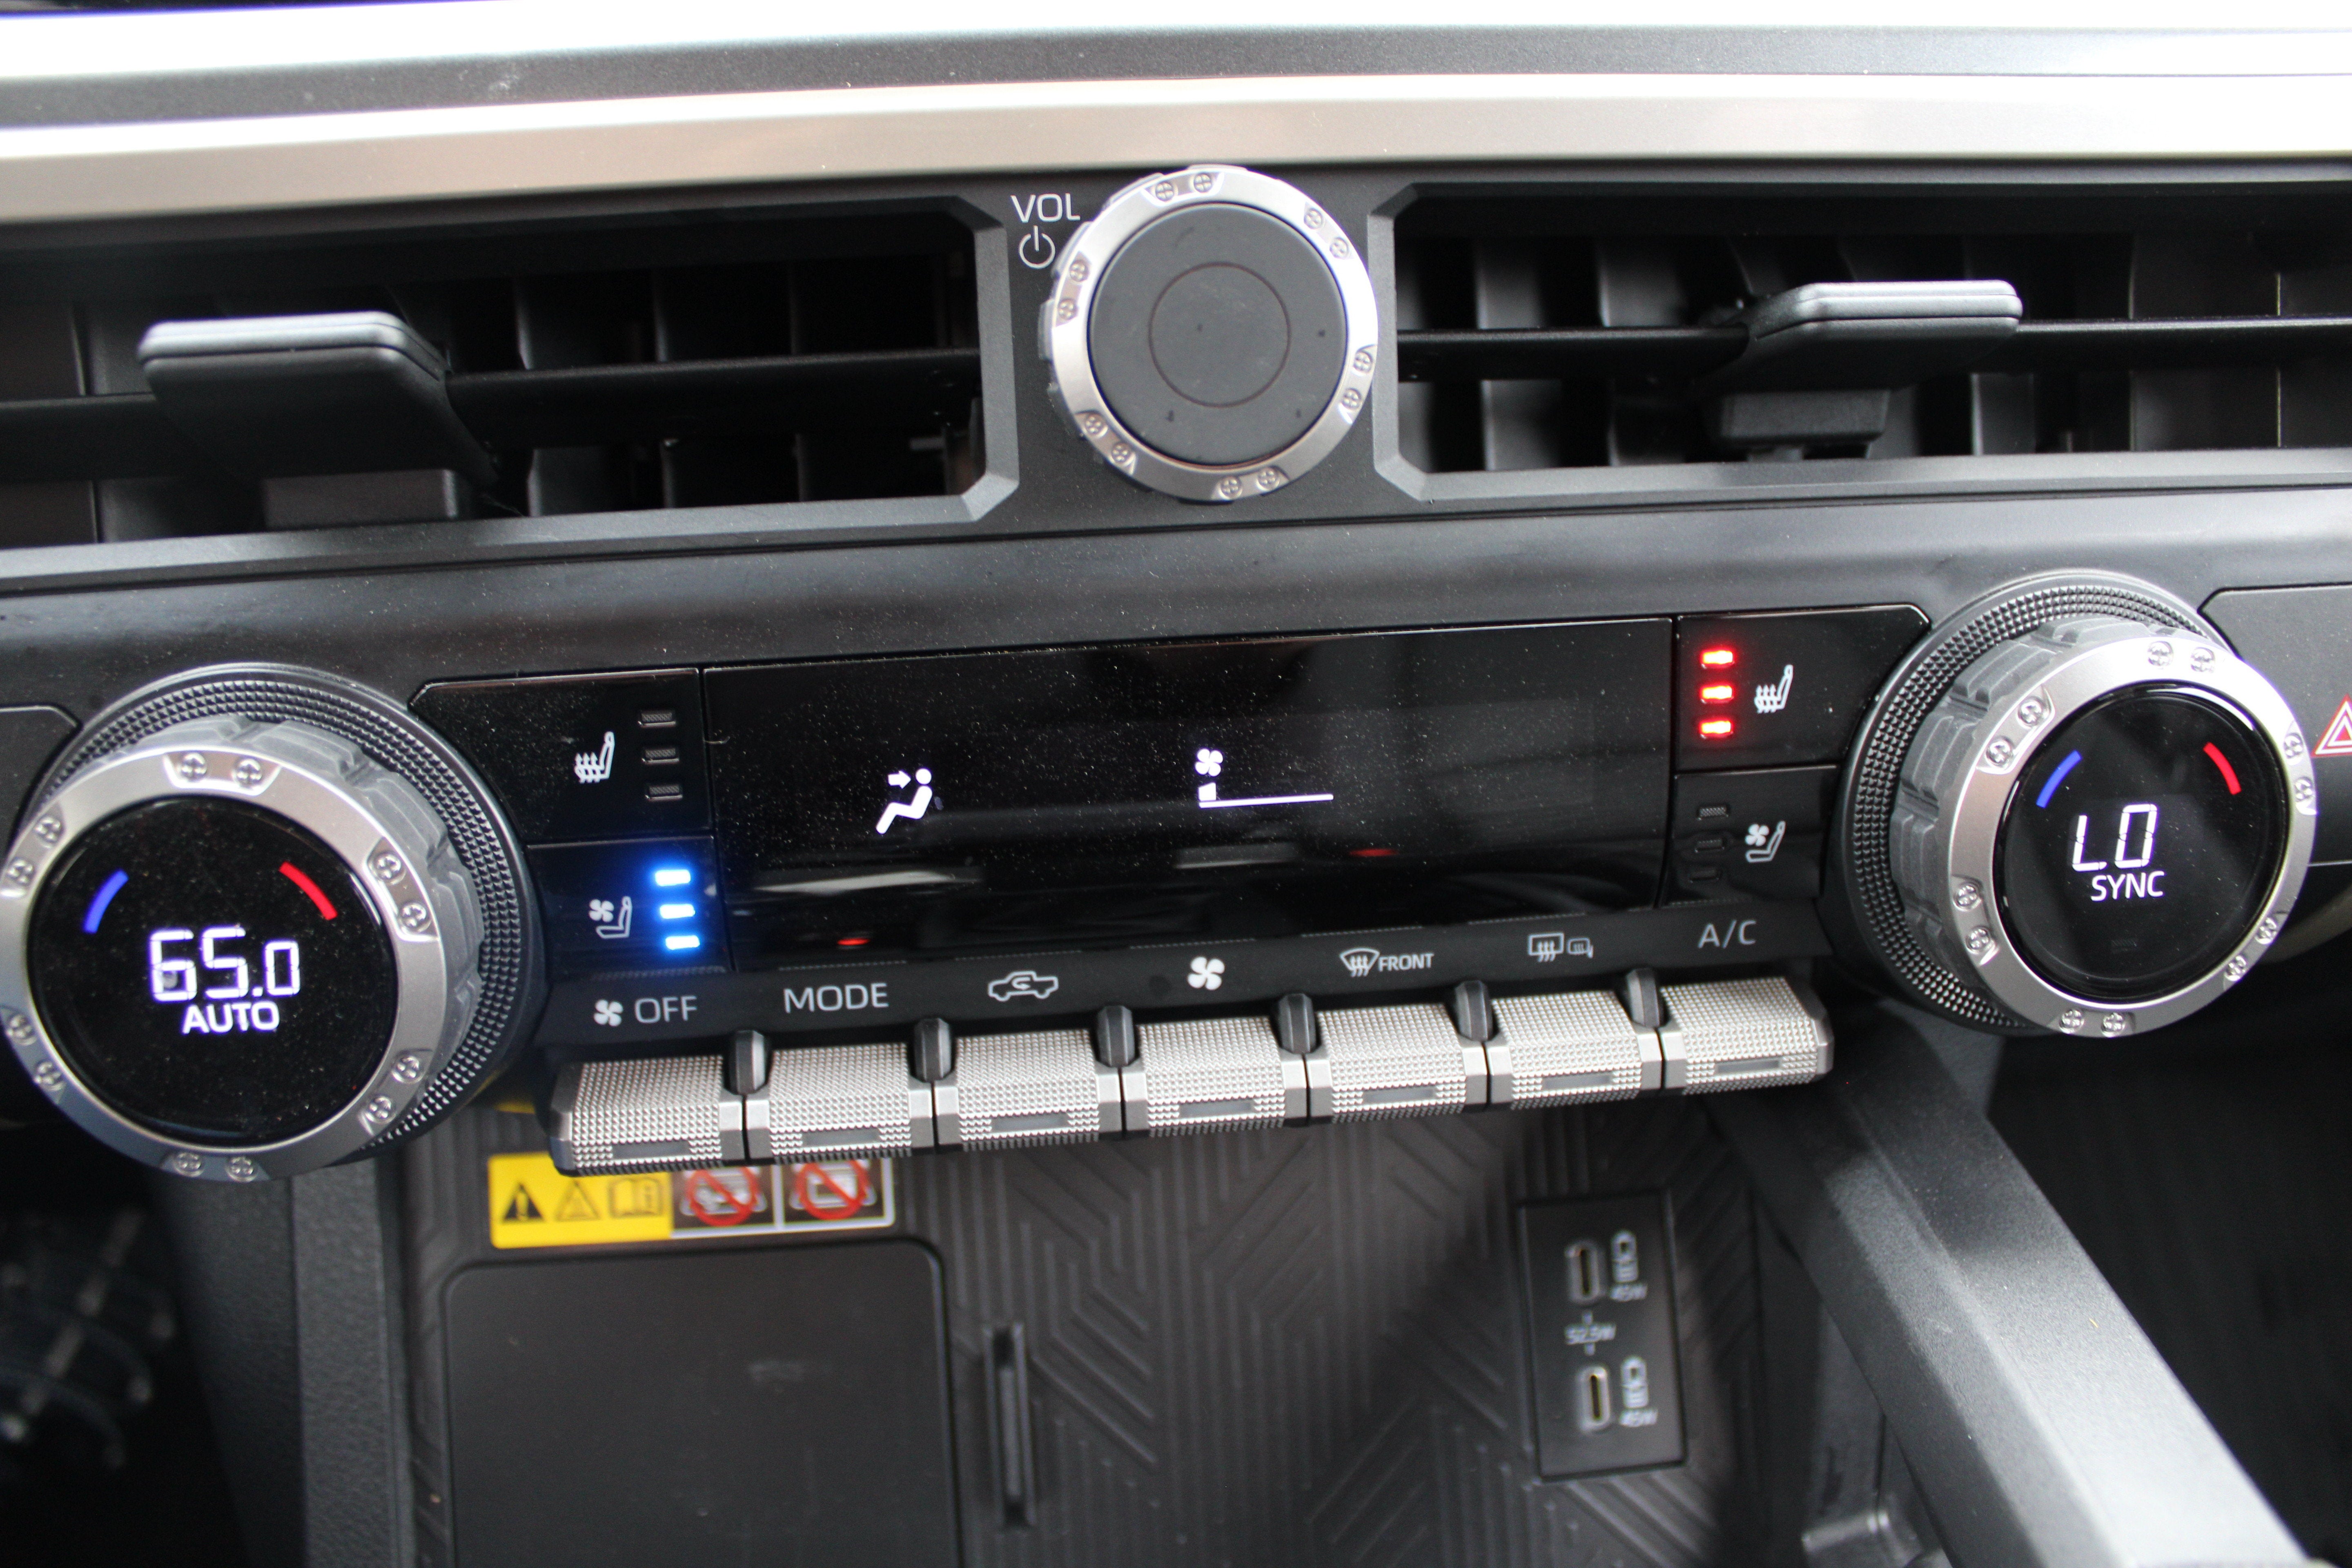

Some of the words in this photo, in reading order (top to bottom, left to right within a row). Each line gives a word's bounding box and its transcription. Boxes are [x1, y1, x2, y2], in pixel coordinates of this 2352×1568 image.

[1010, 193, 1080, 223] VOL
[2091, 871, 2165, 902] SYNC
[1697, 920, 1756, 949] A/C
[150, 926, 301, 1002] 65.0
[1379, 952, 1434, 972] FRONT
[635, 995, 697, 1024] OFF
[783, 982, 889, 1013] MODE
[181, 1000, 280, 1035] AUTO
